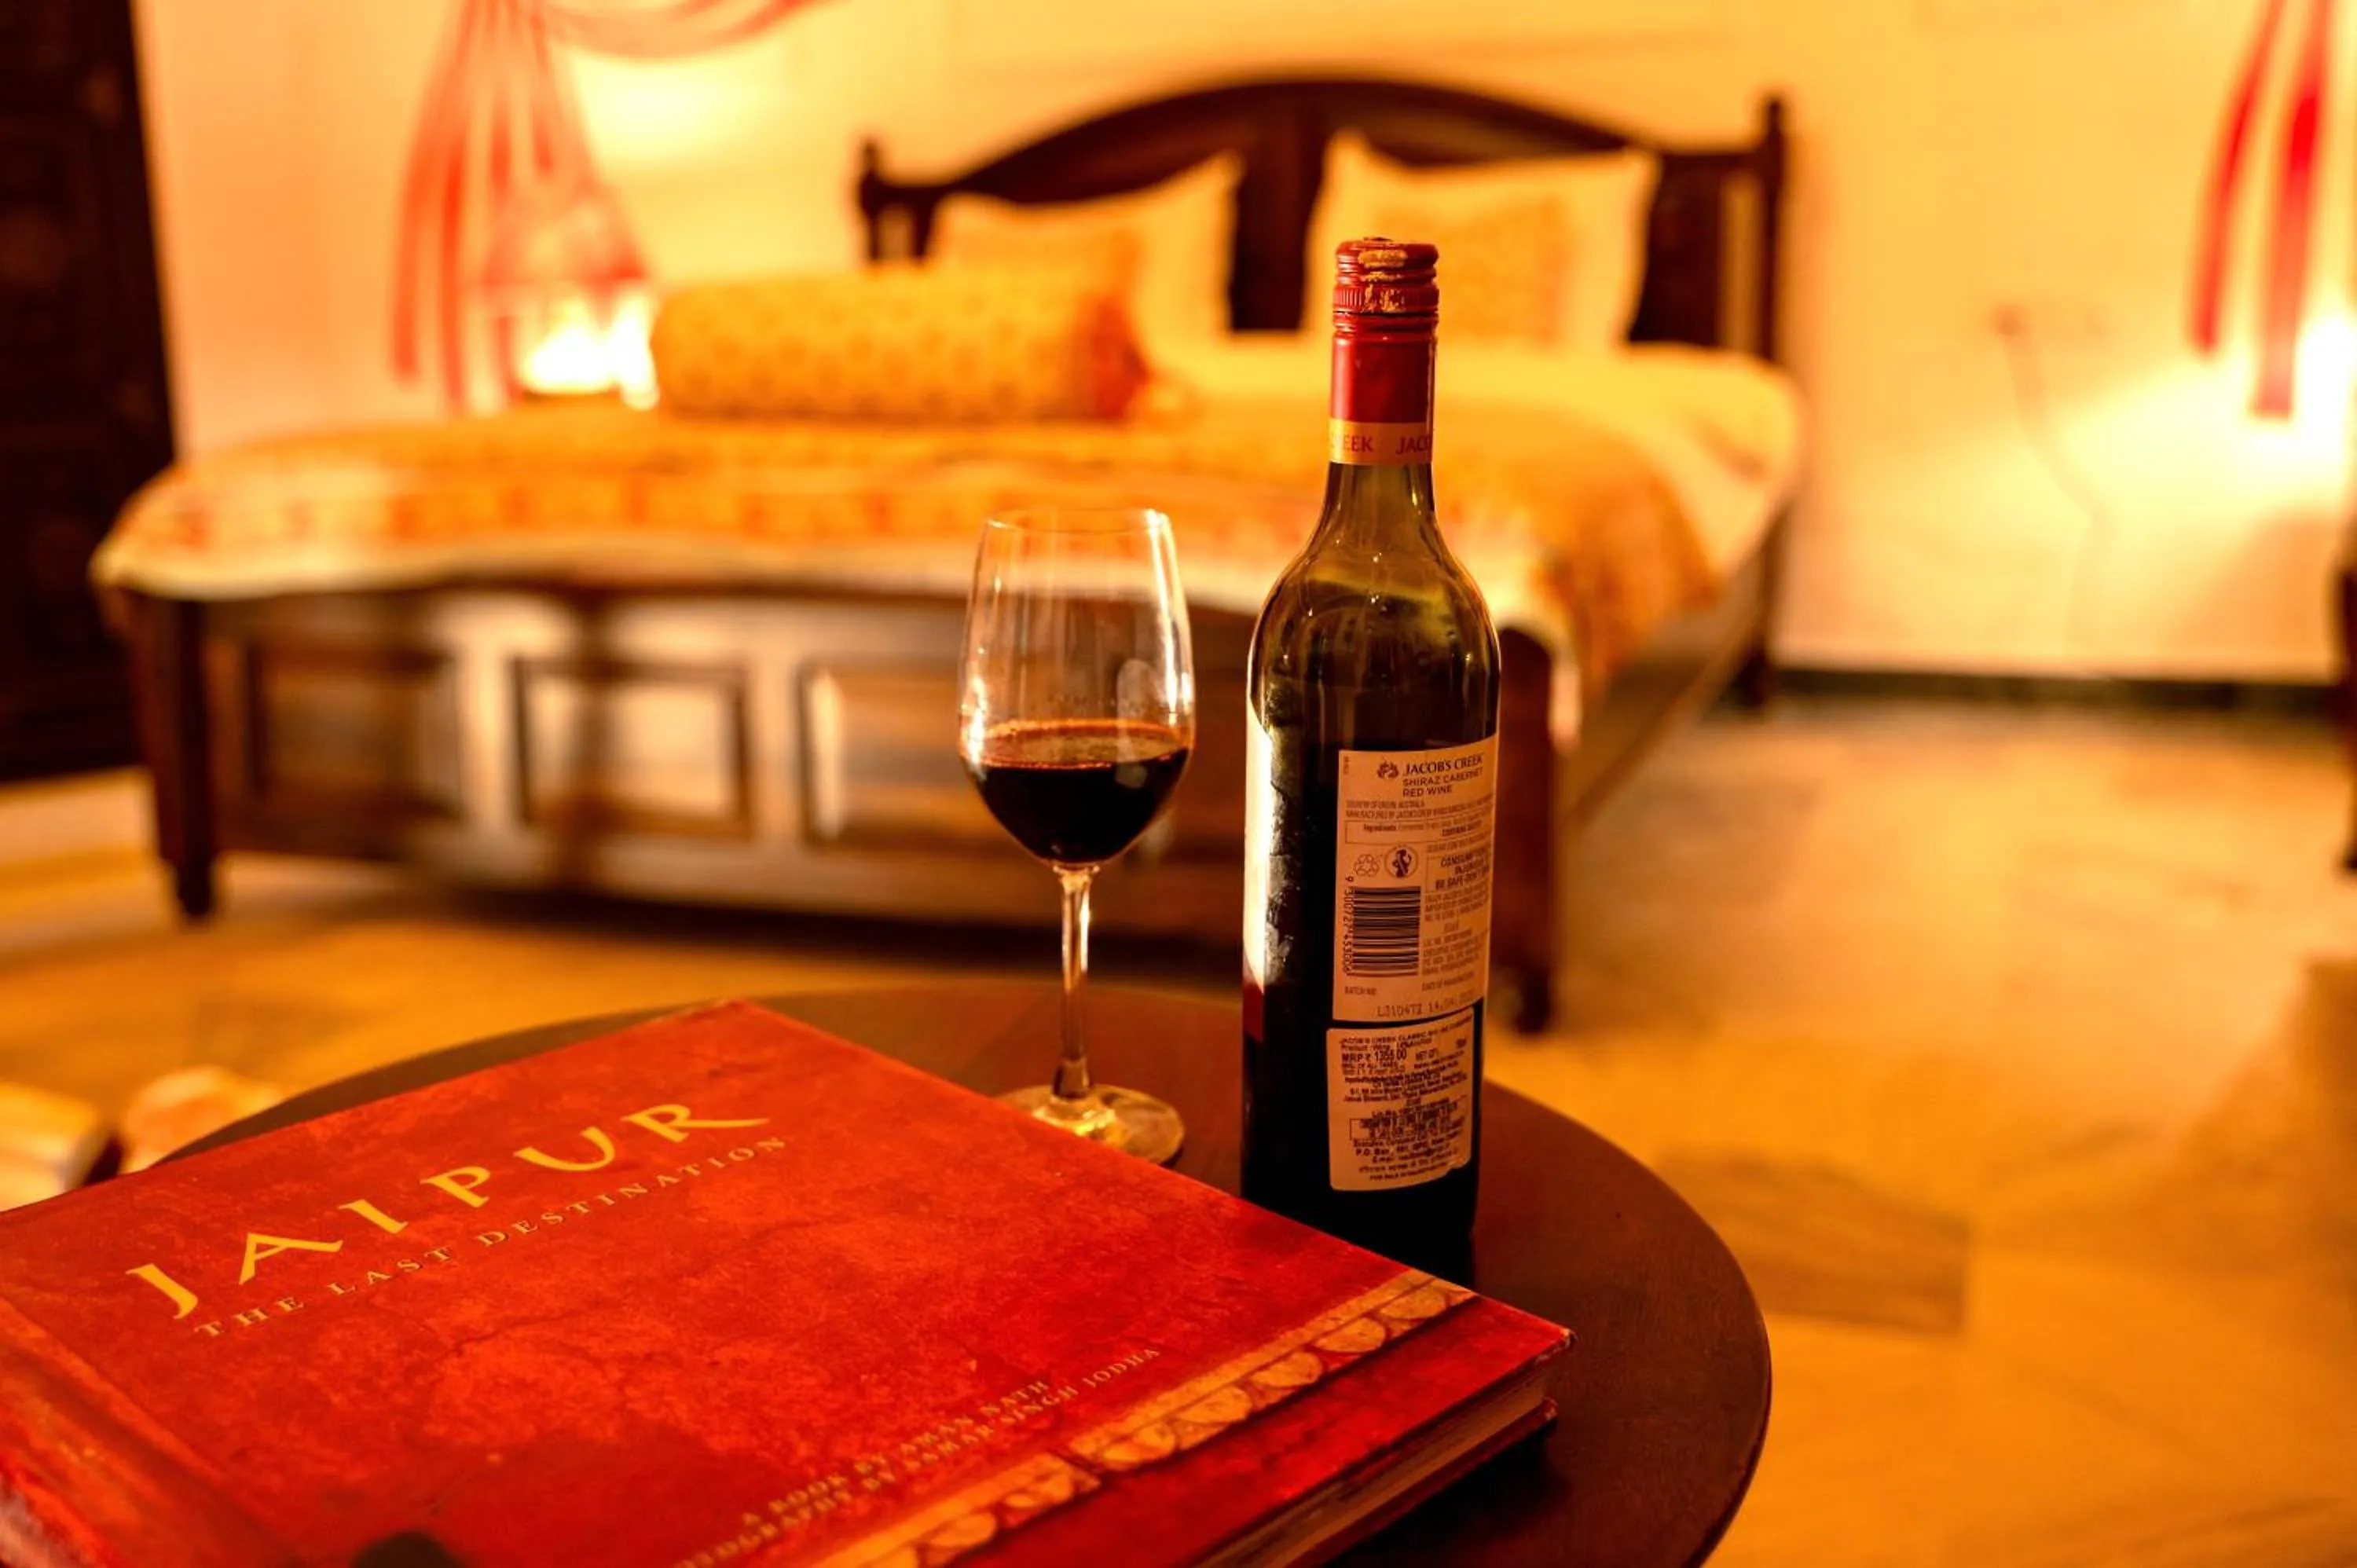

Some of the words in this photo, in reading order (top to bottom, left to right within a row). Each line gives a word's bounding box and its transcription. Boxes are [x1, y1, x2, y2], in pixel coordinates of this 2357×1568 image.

[1343, 434, 1373, 452] EEK
[1454, 755, 1483, 769] CREEK
[1402, 776, 1441, 786] SHIRAZ
[1402, 788, 1424, 797] RED
[1427, 786, 1452, 795] WINE
[1342, 1053, 1363, 1061] MRP
[126, 1104, 772, 1320] JAIPUR
[193, 1295, 306, 1339] THE
[327, 1246, 456, 1297] LAST
[477, 1136, 786, 1247] DESTINATION
[978, 1380, 1049, 1415] NATH
